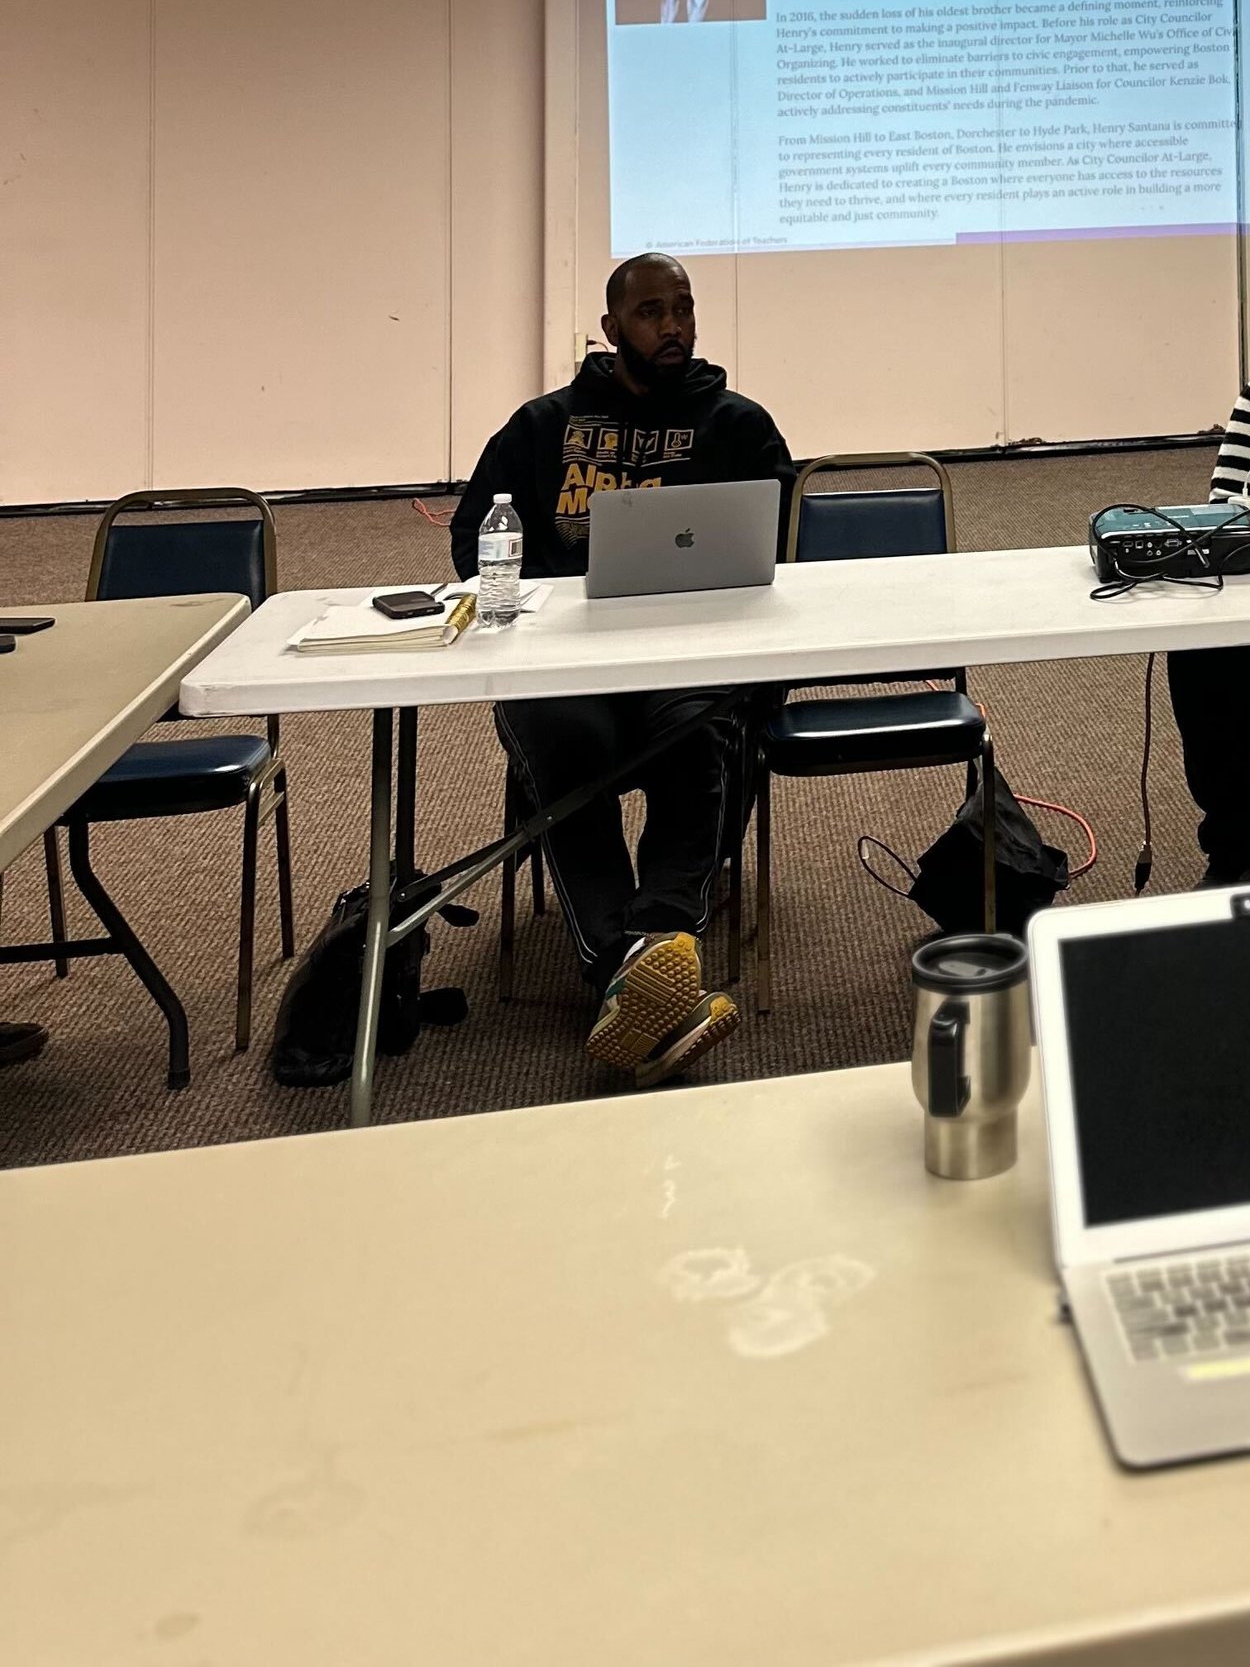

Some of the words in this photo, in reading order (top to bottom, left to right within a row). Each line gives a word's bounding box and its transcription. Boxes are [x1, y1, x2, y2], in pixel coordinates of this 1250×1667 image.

[776, 13, 787, 22] In
[819, 10, 837, 20] the
[840, 9, 879, 20] sudden
[881, 8, 902, 18] loss
[904, 7, 916, 17] of
[917, 7, 933, 17] his
[936, 6, 969, 16] oldest
[971, 4, 1012, 15] brother
[1014, 3, 1056, 13] became
[1067, 0, 1111, 12] defining
